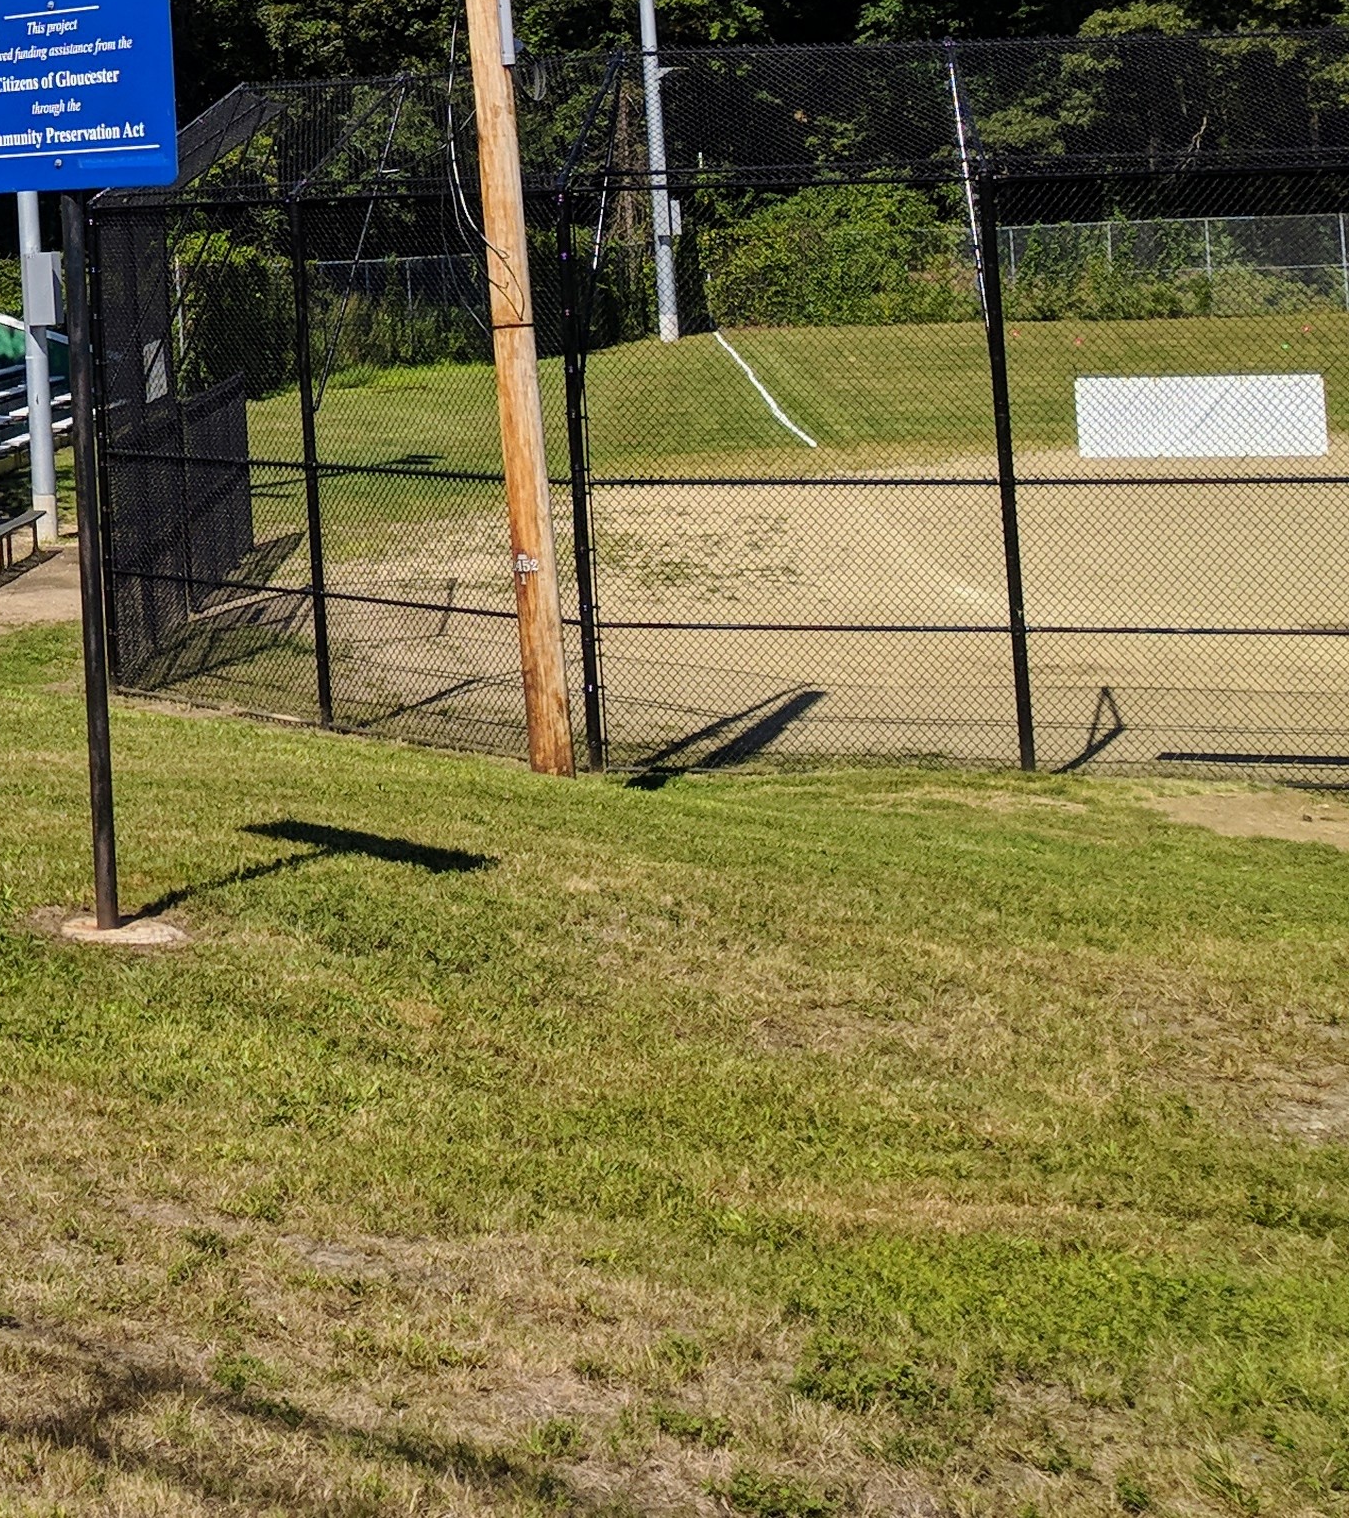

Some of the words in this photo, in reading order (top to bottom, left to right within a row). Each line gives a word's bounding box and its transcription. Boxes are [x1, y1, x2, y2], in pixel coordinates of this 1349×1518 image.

[27, 21, 45, 35] This
[46, 19, 78, 36] project
[13, 45, 48, 64] funding
[48, 43, 94, 57] assistance
[93, 38, 116, 56] from
[117, 35, 133, 49] the
[41, 72, 54, 89] of
[55, 68, 120, 88] Gloucester
[31, 99, 66, 116] through
[67, 98, 81, 112] the
[45, 123, 121, 144] Preservation
[122, 121, 145, 139] Act
